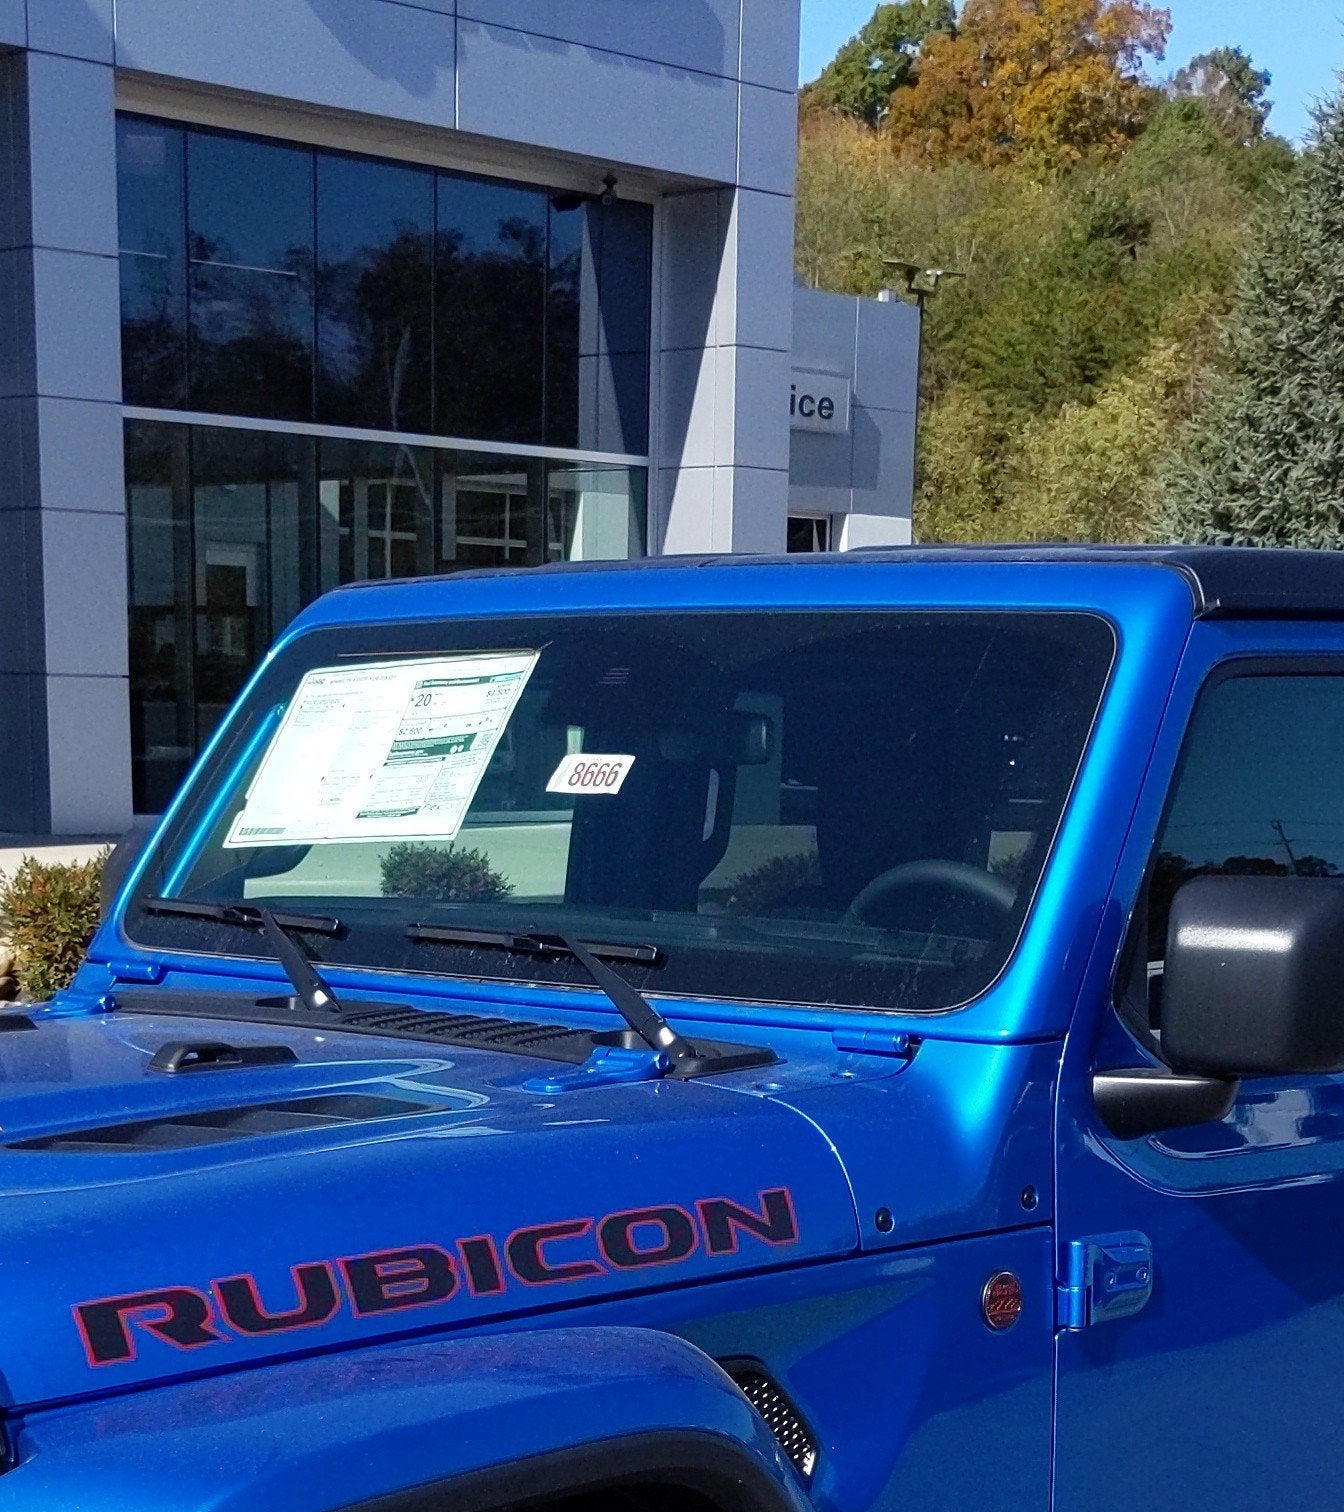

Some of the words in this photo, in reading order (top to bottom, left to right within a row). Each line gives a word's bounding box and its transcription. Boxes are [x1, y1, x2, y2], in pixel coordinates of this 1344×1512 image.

[414, 693, 432, 708] 20
[567, 762, 623, 787] 8666
[71, 1187, 800, 1368] RUBICON
